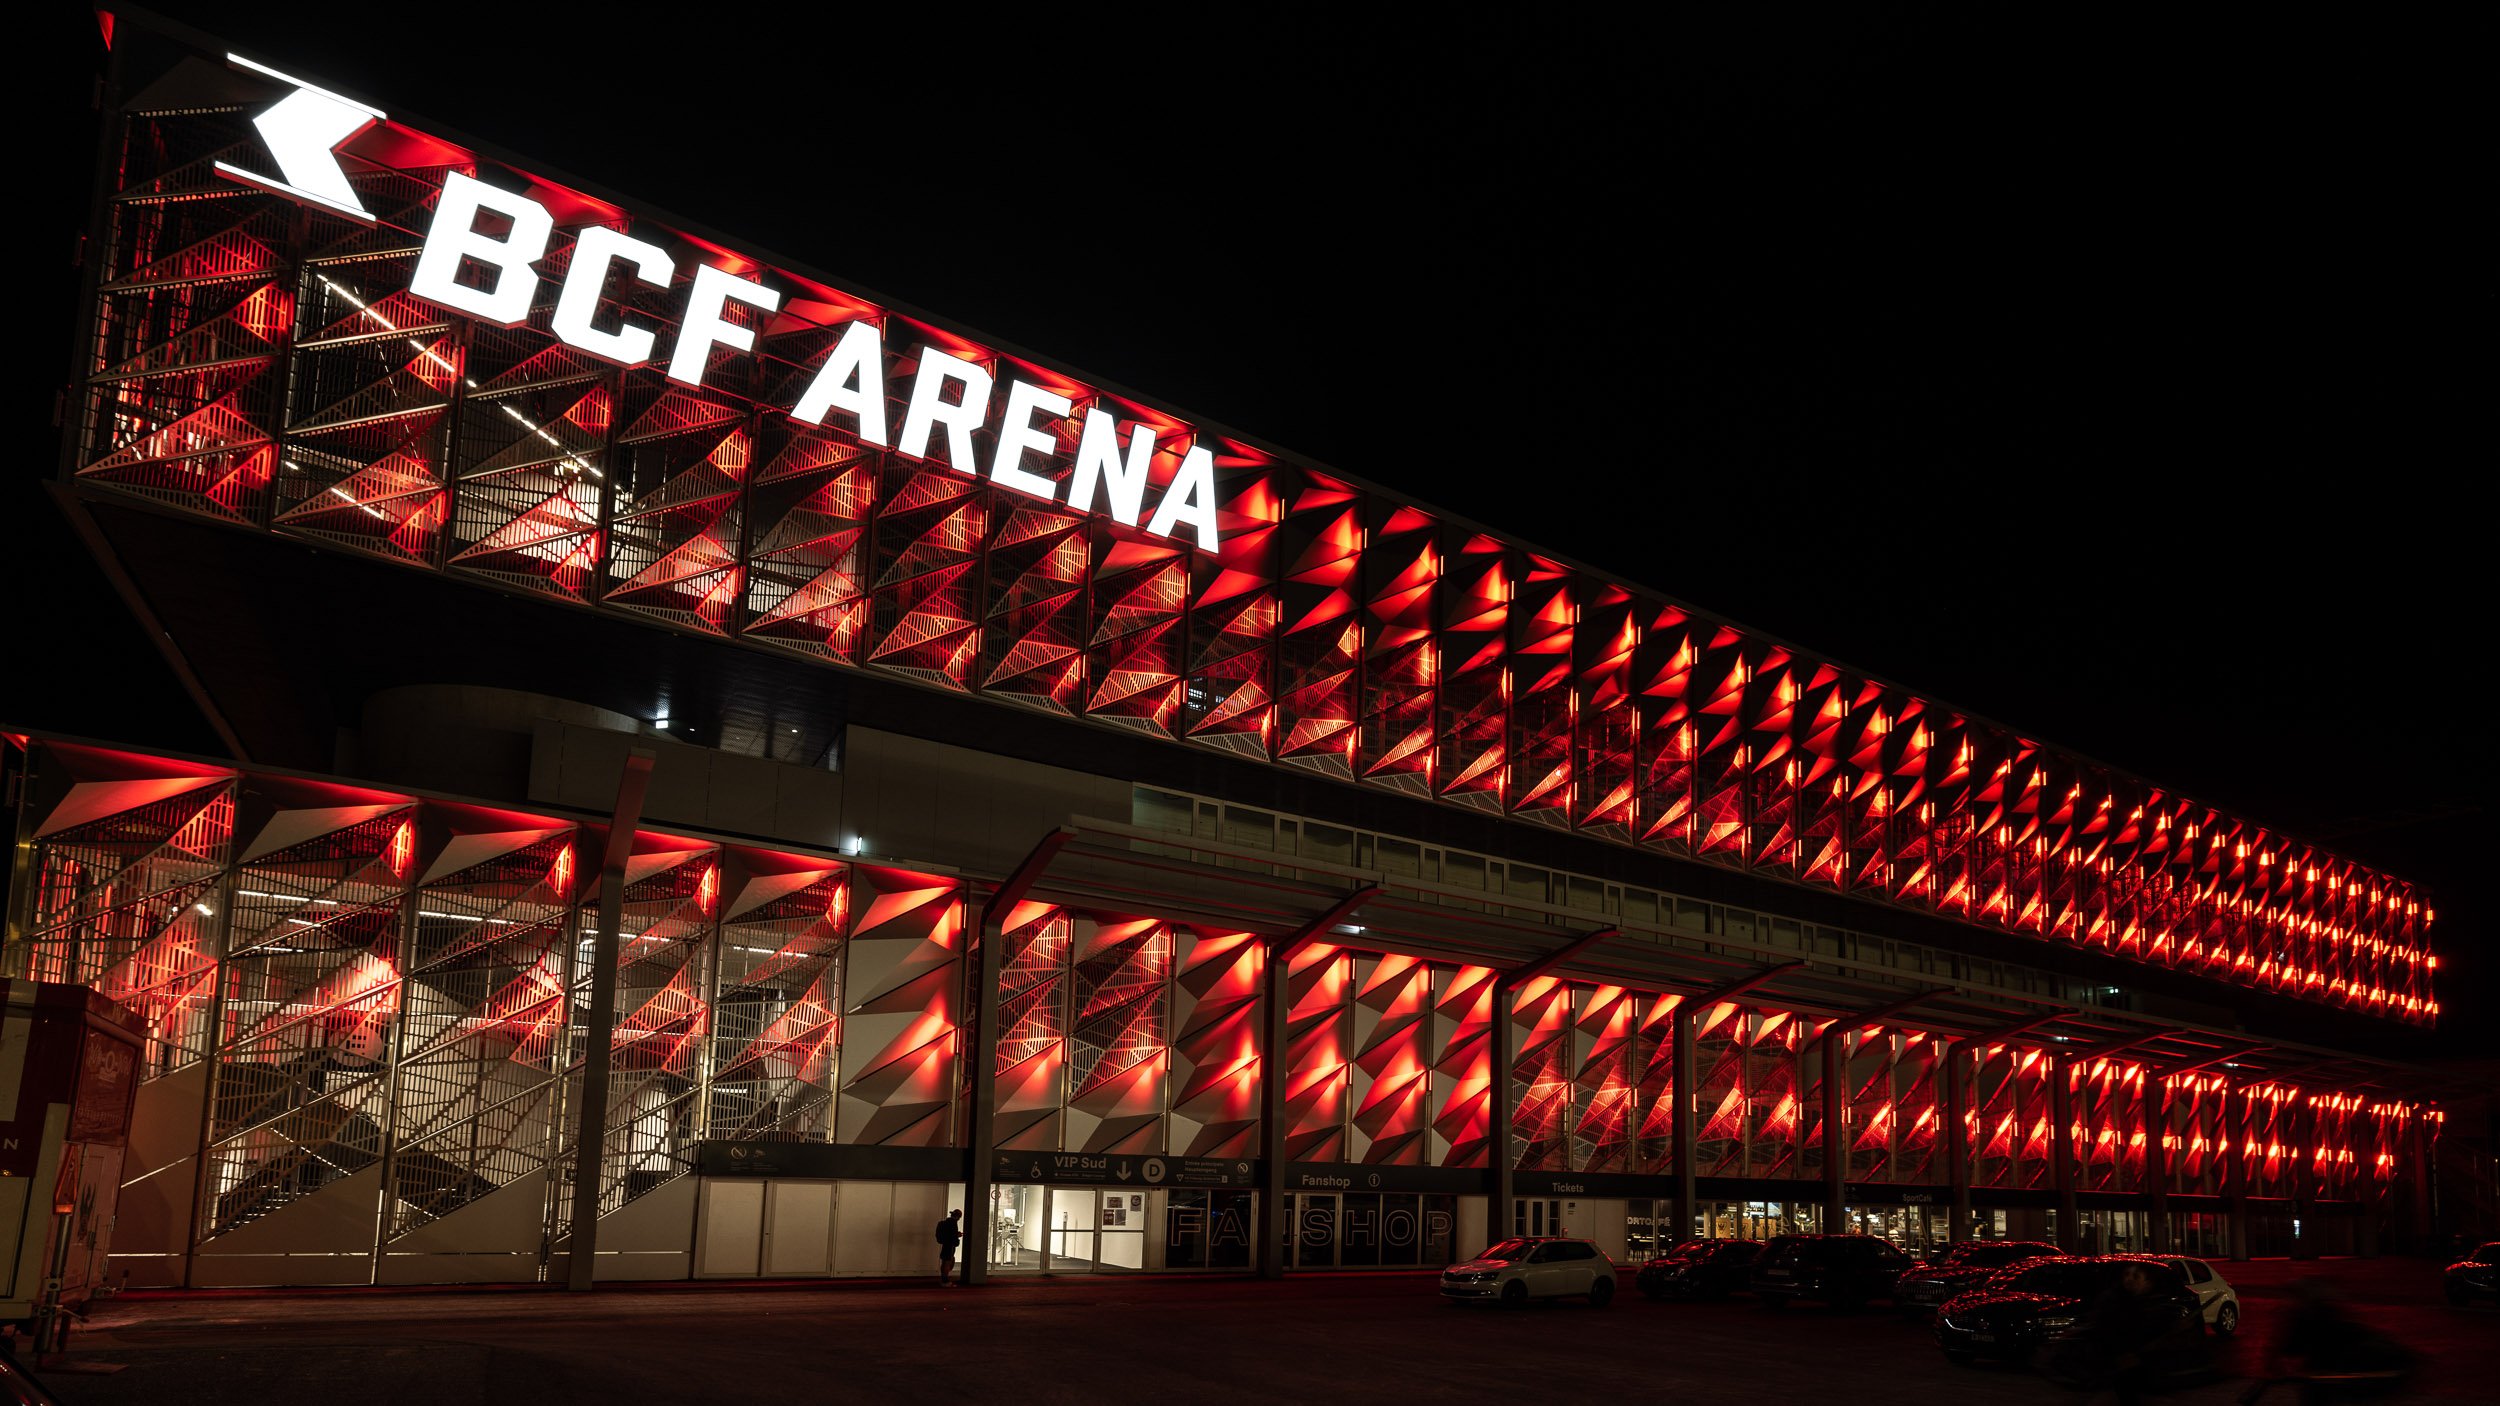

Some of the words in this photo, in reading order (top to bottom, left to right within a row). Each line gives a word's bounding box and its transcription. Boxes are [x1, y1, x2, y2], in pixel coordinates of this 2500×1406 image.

[409, 170, 780, 386] BCF
[790, 320, 1219, 554] ARENA
[1054, 1156, 1079, 1168] VIP
[1080, 1156, 1107, 1169] Sud
[1302, 1174, 1351, 1189] Fanshop
[1552, 1182, 1584, 1193] Tickets
